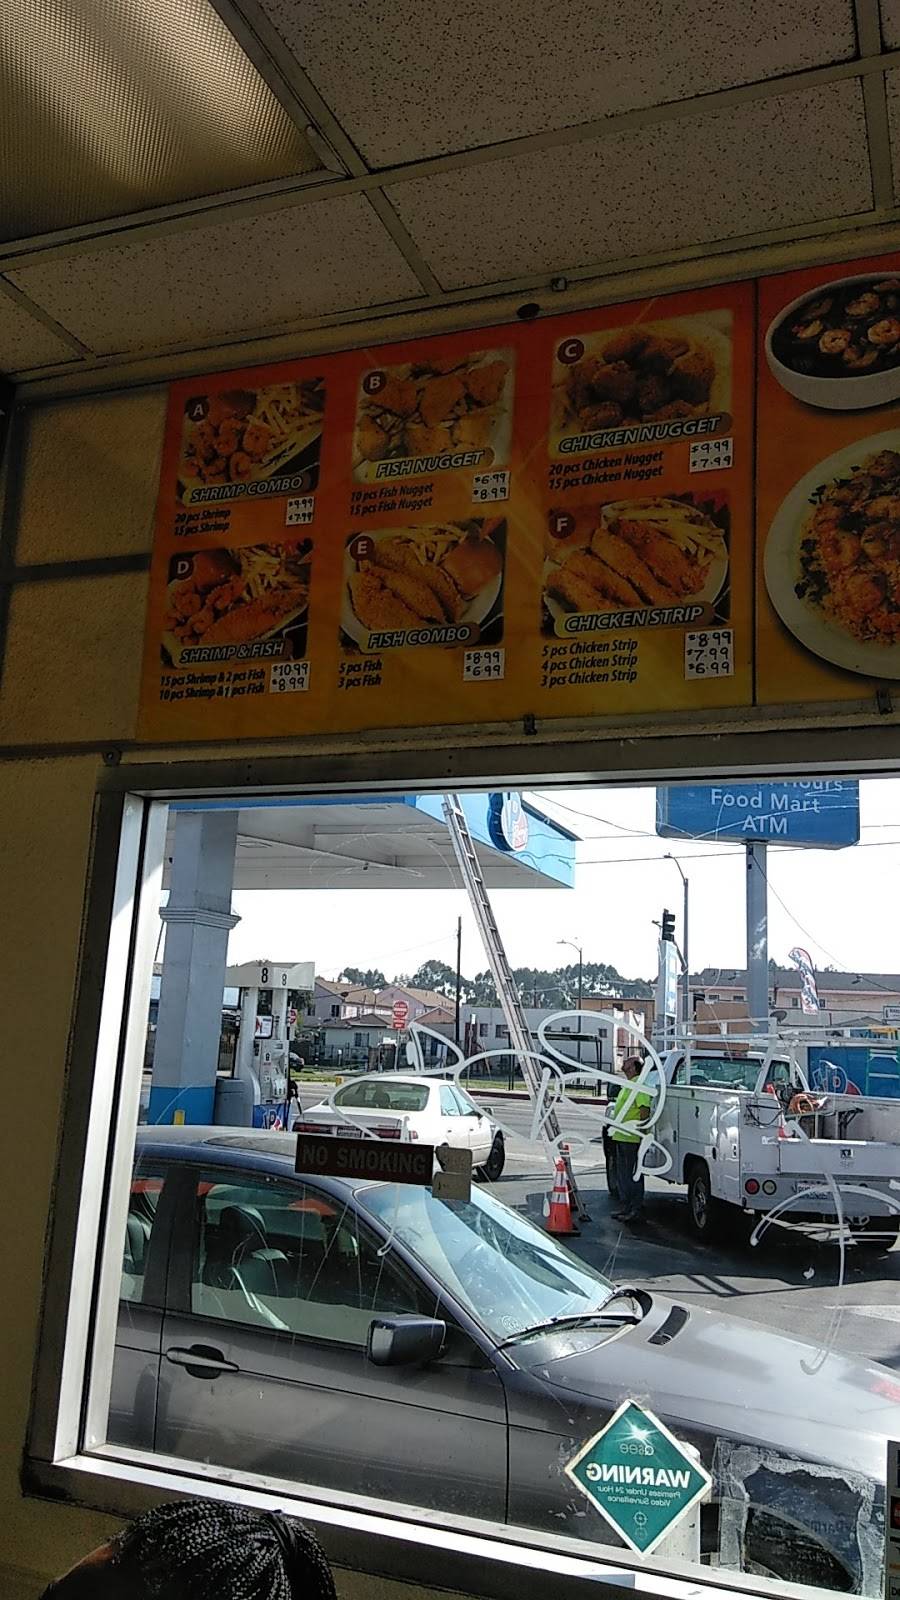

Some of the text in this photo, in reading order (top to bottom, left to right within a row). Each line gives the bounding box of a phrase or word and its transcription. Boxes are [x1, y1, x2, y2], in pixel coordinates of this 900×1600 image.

[565, 344, 577, 357] C
[369, 376, 381, 389] B
[193, 404, 204, 417] A
[559, 417, 721, 453] CHICKEN NUGGET
[692, 440, 729, 454] $9.99
[376, 450, 485, 478] FISH NUGGET
[549, 451, 663, 477] 20 pcs Chicken Nugget
[692, 455, 731, 467] $7.99
[475, 473, 507, 484] $6.99
[549, 465, 663, 491] 15 pcs Chicken Nugget
[191, 477, 303, 502] SHRIMP COMBO
[362, 490, 378, 501] pcs
[379, 485, 398, 498] Fish
[399, 483, 434, 497] Nugget
[474, 487, 507, 500] $8.99
[201, 508, 231, 521] Shrimp
[361, 504, 377, 516] pcs
[378, 500, 397, 513] Fish
[398, 497, 433, 512] Nugget
[200, 521, 230, 533] Shrimp
[556, 517, 568, 533] F
[357, 541, 368, 554] E
[177, 560, 189, 574] D
[565, 606, 704, 633] CHICKEN STRIP
[368, 626, 471, 649] FISH COMBO
[688, 631, 731, 647] $8.99
[180, 640, 285, 664] SHRIMP & FISH
[466, 651, 500, 664] $8.99
[541, 638, 638, 660] 5 pcs Chicken Strip
[687, 648, 729, 661] $7.99
[338, 658, 382, 675] 5 pcs Fish
[466, 665, 501, 677] $6.99
[541, 653, 638, 674] 4 pcs Chicken Strip
[689, 662, 730, 674] $6.99
[160, 675, 171, 685] 15
[170, 675, 185, 688] pcs
[185, 671, 217, 686] Shrimp
[231, 671, 247, 683] pcs
[247, 668, 265, 680] Fish
[338, 673, 382, 690] 3 pcs Fish
[541, 669, 637, 689] 3 pcs Chicken Strip
[160, 689, 170, 700] 10
[169, 690, 184, 702] pcs
[184, 685, 216, 700] Shrimp
[231, 685, 247, 698] pcs
[246, 682, 265, 695] Fish
[711, 788, 821, 813] Food Mart
[742, 815, 788, 834] ATM
[261, 967, 288, 986] 8 8
[303, 1145, 328, 1166] NO
[336, 1148, 426, 1174] SMOKING
